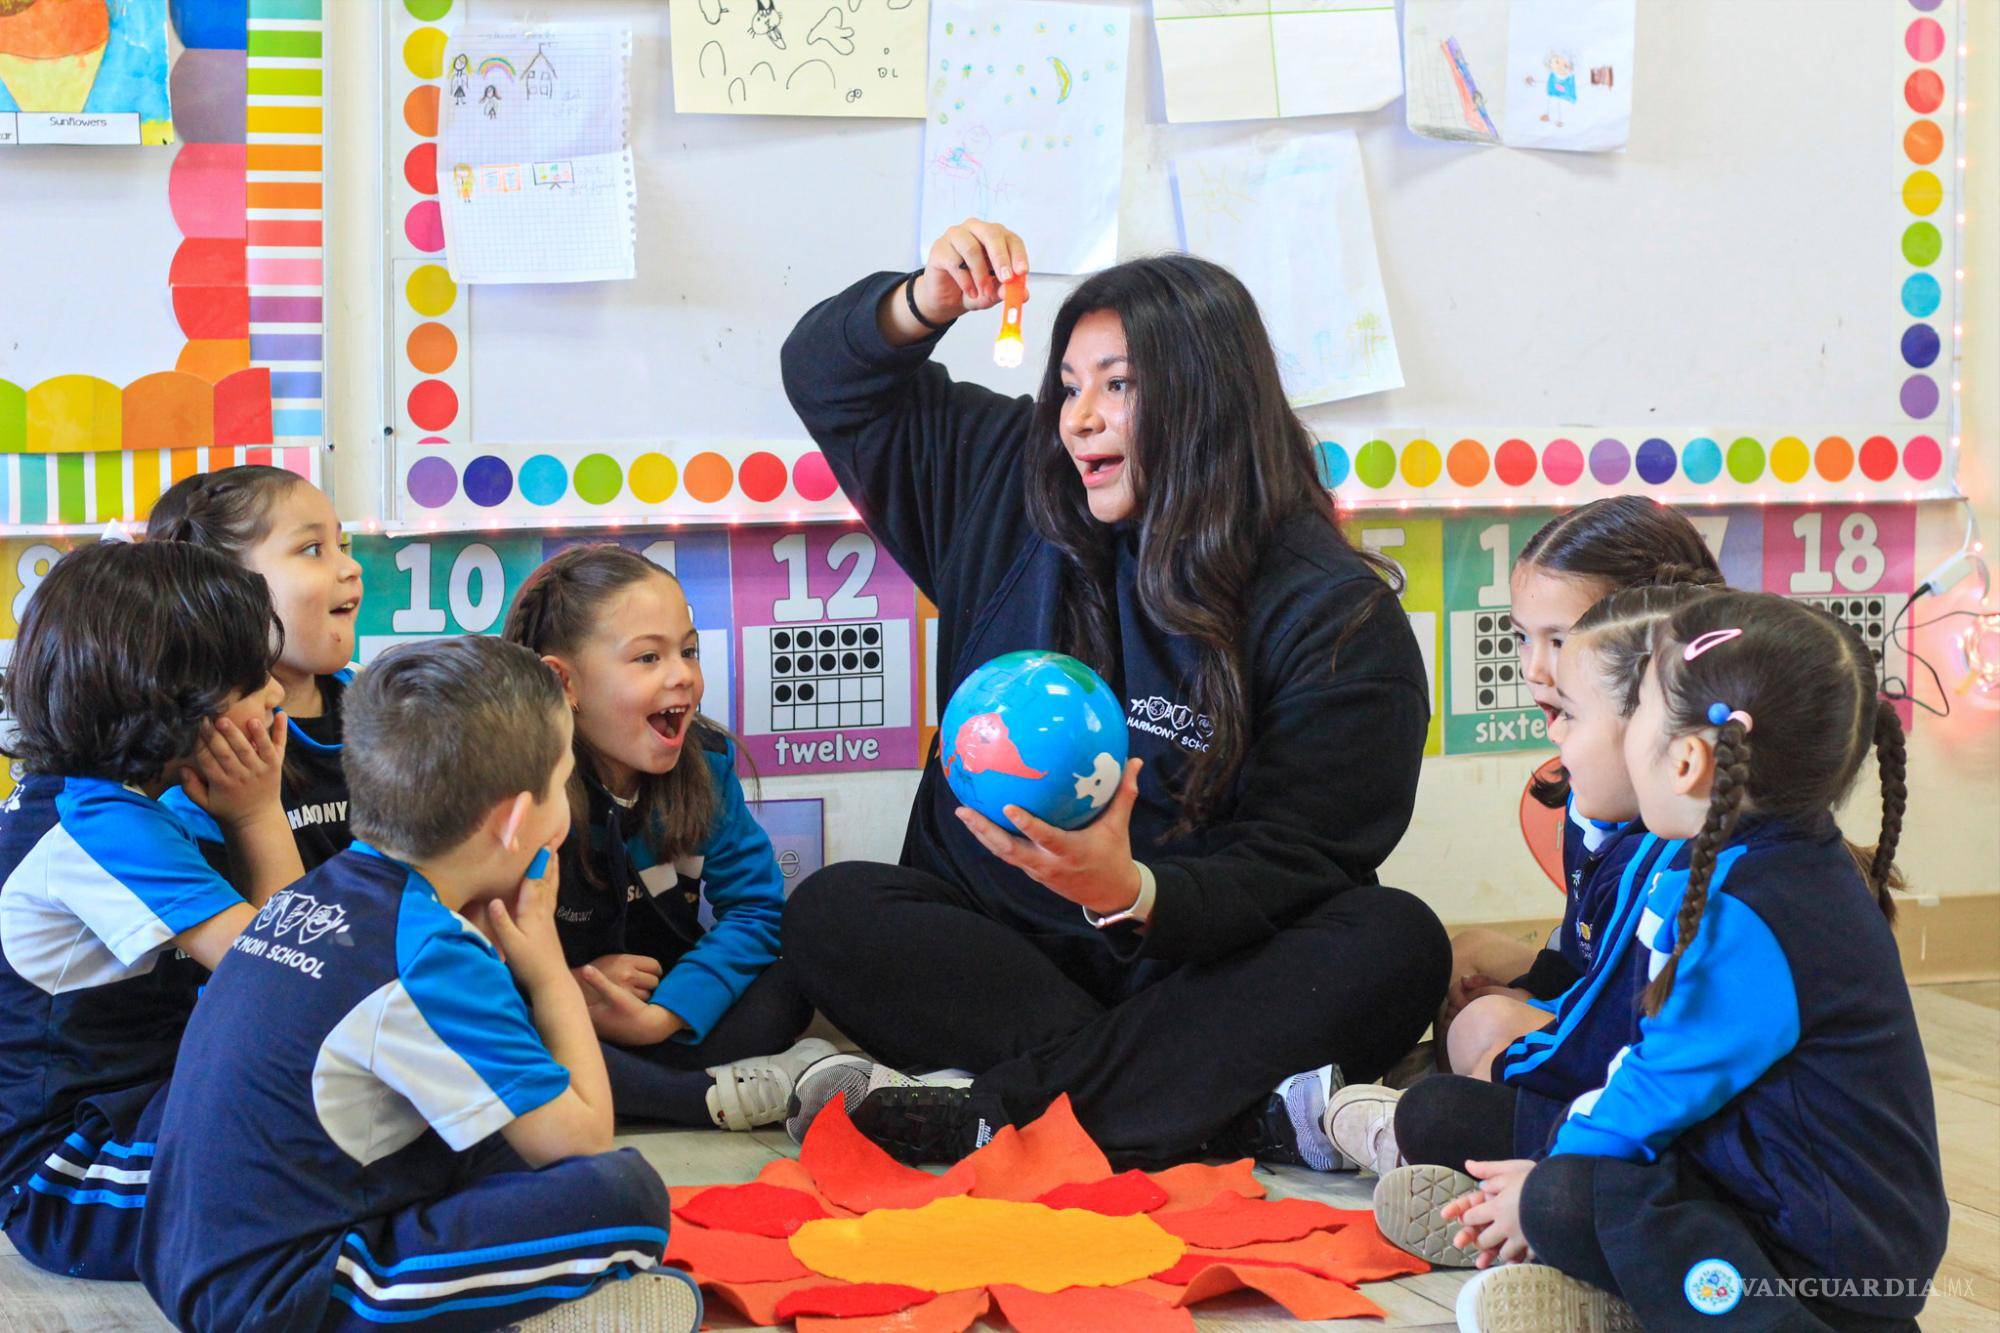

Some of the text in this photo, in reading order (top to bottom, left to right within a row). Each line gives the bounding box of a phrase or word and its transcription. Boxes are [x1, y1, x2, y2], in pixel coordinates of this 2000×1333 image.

[49, 116, 107, 127] Sunflowers
[1477, 523, 1512, 607] 1
[1790, 512, 1885, 592] 18
[392, 542, 506, 633] 10
[772, 532, 879, 622] 12
[1126, 716, 1178, 741] HARMONY
[1475, 713, 1546, 743] sixte
[775, 732, 879, 766] twelve
[265, 943, 326, 980] SCHOOL
